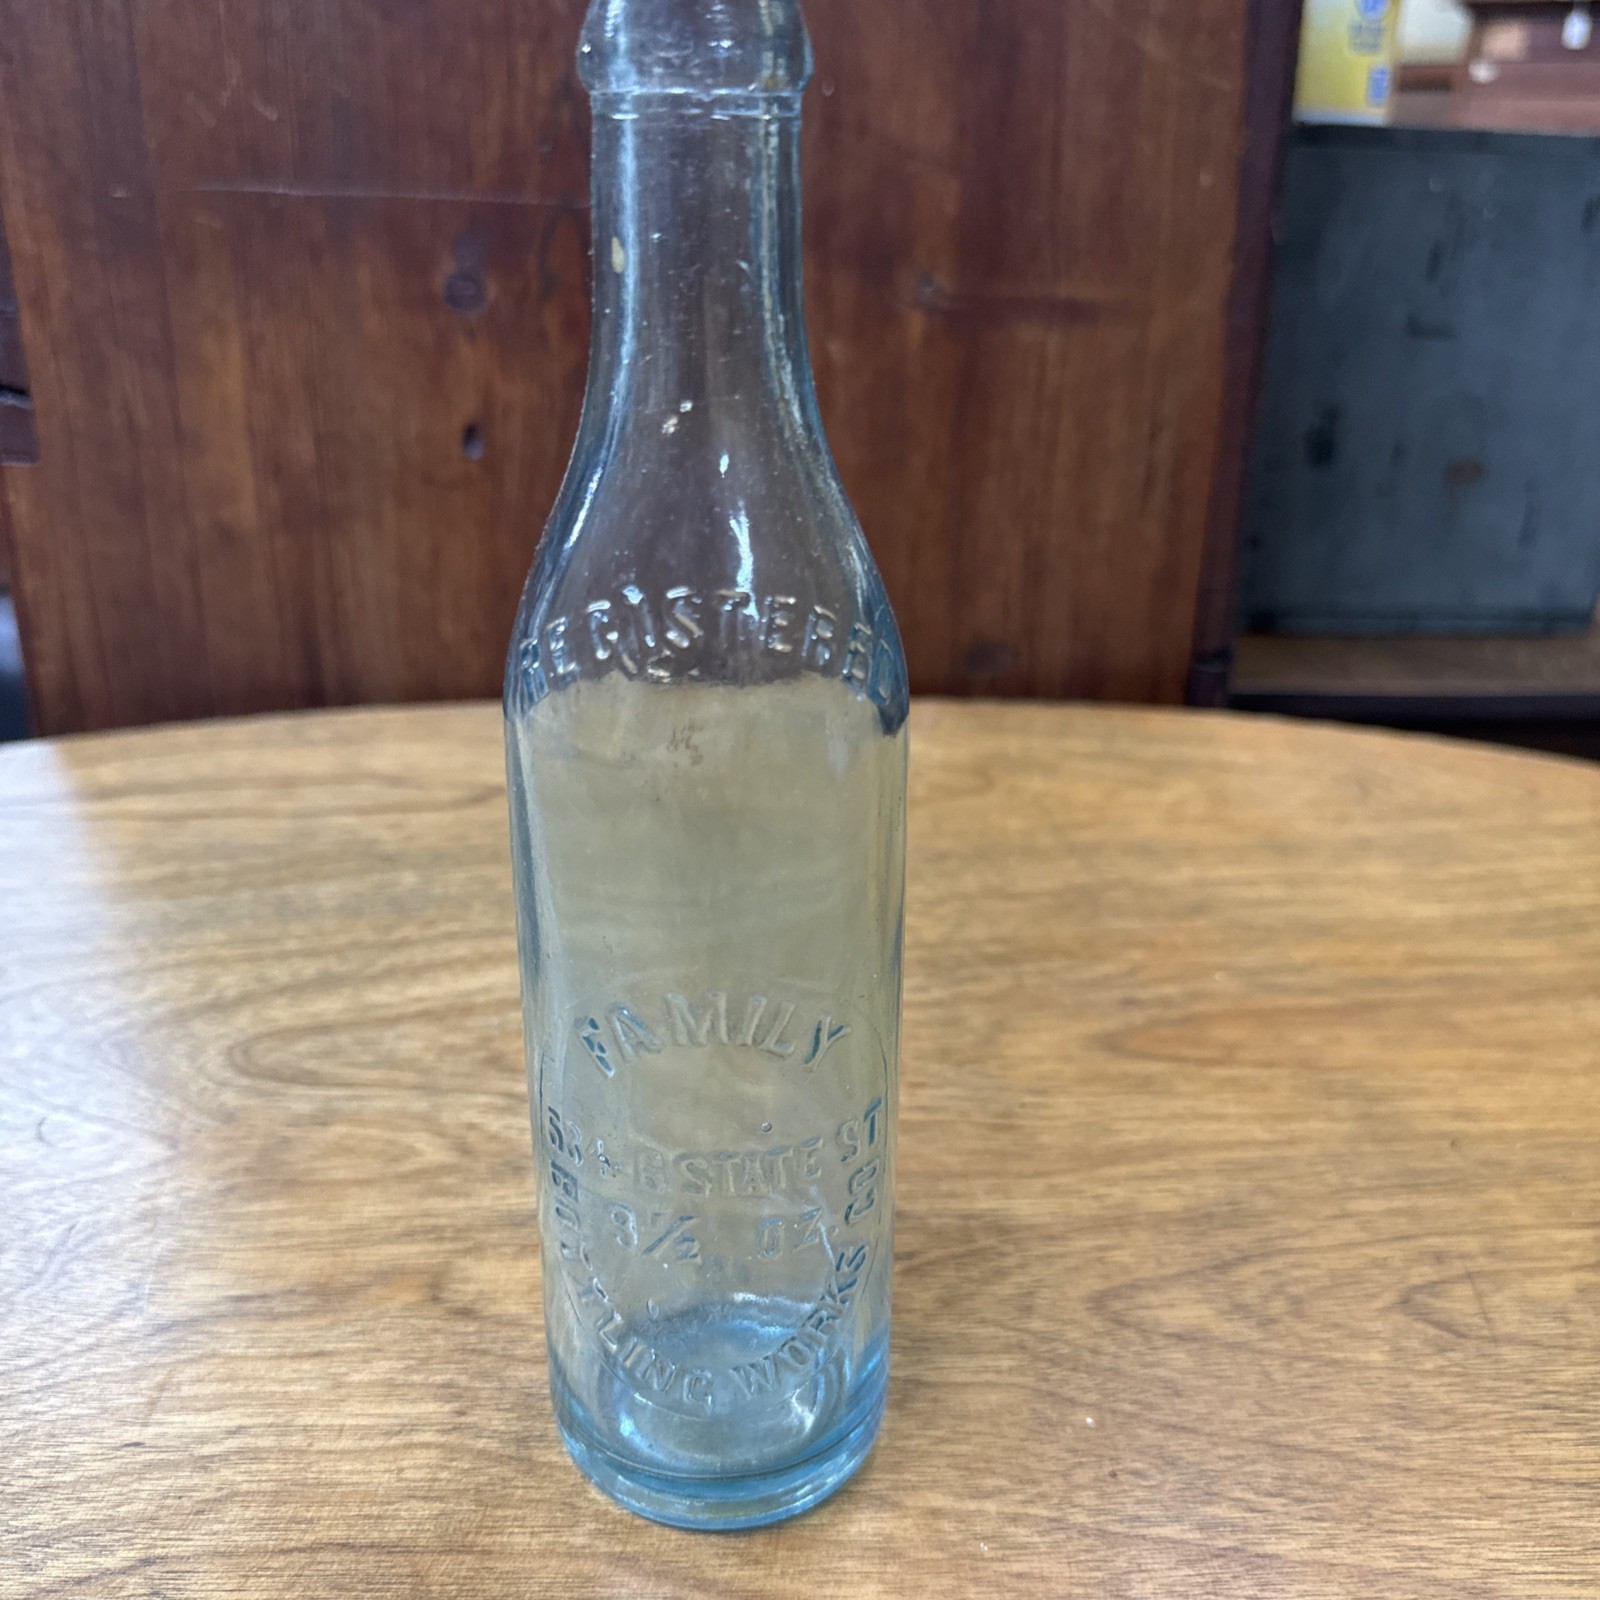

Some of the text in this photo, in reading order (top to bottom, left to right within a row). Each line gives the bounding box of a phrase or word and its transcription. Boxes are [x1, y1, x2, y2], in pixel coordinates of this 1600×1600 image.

[574, 990, 851, 1078] FAMILY
[674, 1136, 823, 1198] STATE
[837, 1097, 883, 1163] ST
[728, 1242, 869, 1400] WORKS
